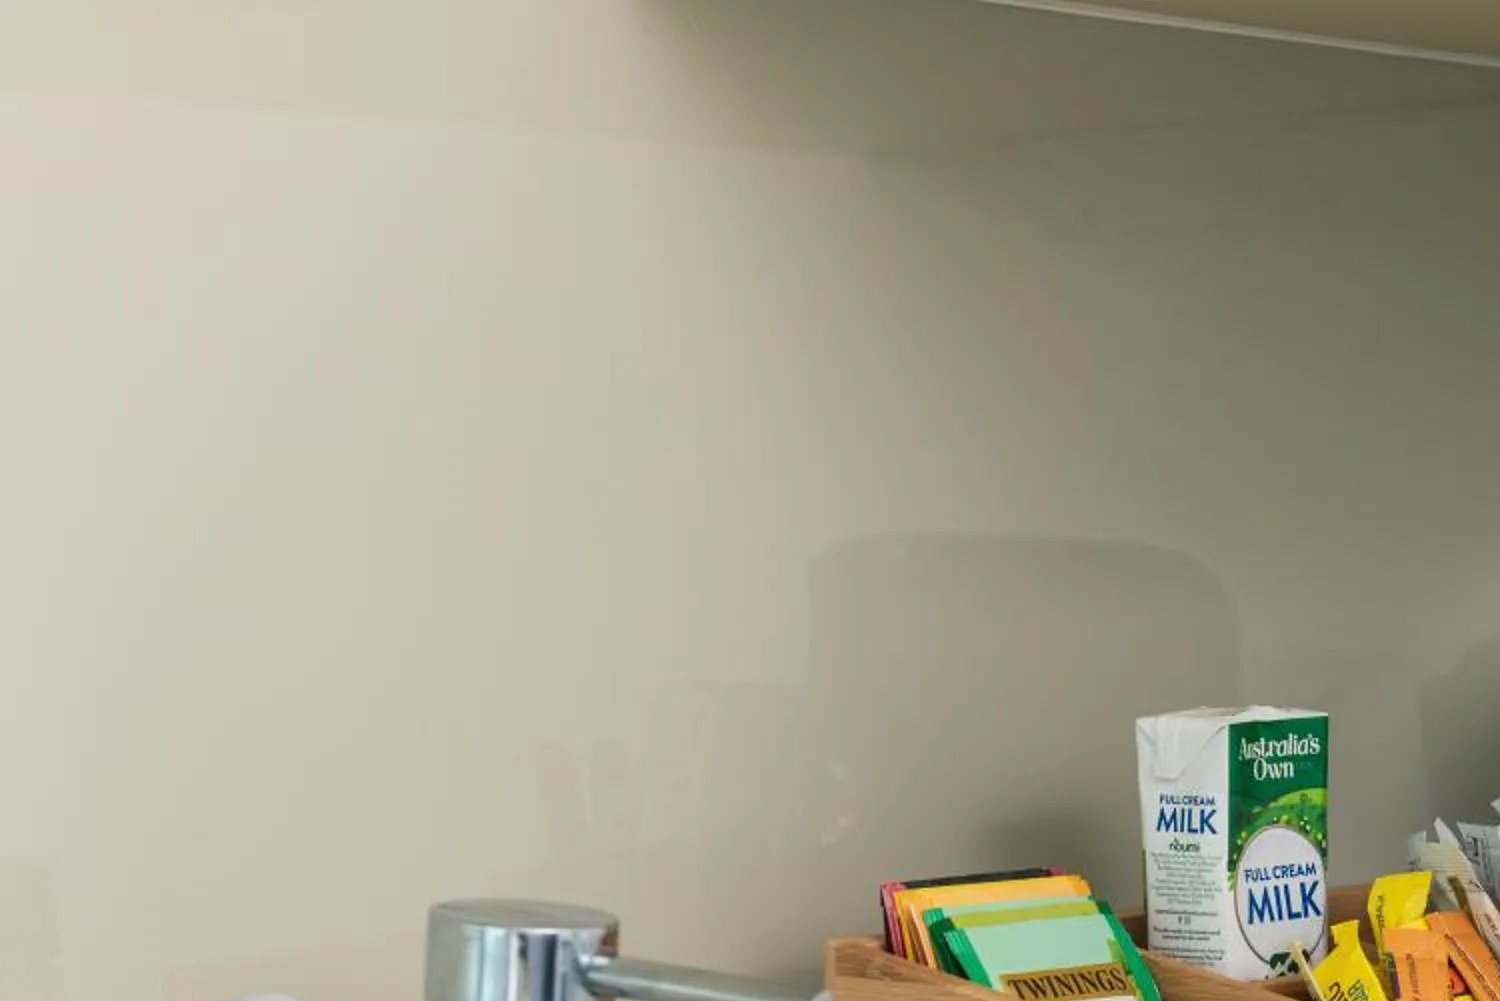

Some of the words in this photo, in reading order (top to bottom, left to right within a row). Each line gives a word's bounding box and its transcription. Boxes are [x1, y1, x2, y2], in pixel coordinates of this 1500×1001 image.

[1238, 733, 1321, 760] Australia's
[1253, 758, 1295, 781] Own
[1159, 793, 1181, 805] FULL
[1182, 795, 1217, 806] CREAM
[1156, 807, 1217, 834] MILK
[1244, 867, 1271, 884] FULL
[1272, 862, 1317, 879] CREAM
[1247, 880, 1322, 925] MILK
[1008, 967, 1127, 1000] TWININGS
